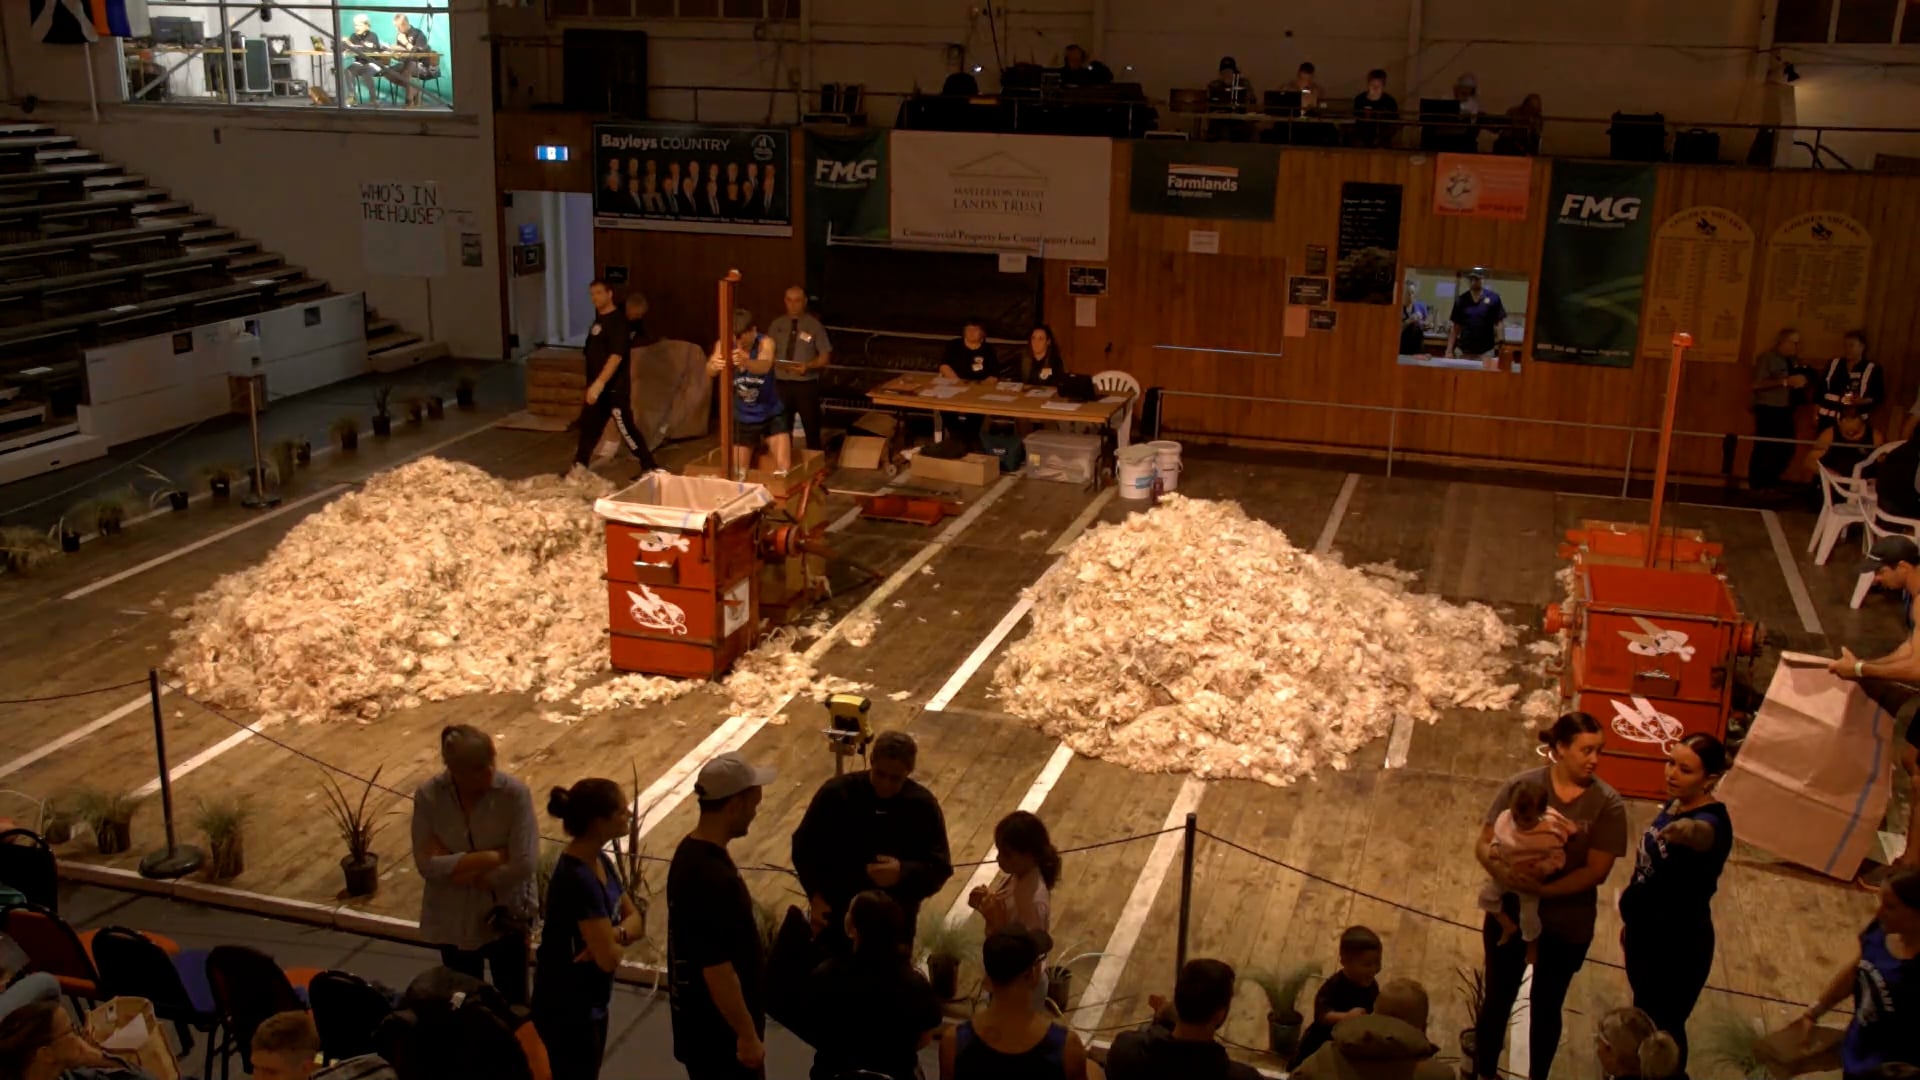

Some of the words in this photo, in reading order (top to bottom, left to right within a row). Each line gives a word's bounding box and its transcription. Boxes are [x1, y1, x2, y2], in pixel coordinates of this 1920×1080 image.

[600, 133, 658, 151] Bayleys
[660, 136, 731, 152] COUNTRY
[815, 158, 880, 183] FMG
[1168, 174, 1239, 192] Farmlands
[361, 183, 405, 204] WHO'S
[412, 185, 437, 206] IN
[954, 199, 998, 209] LANDS
[1002, 200, 1043, 213] TRUST
[1560, 193, 1642, 222] FMG
[959, 230, 996, 243] Property
